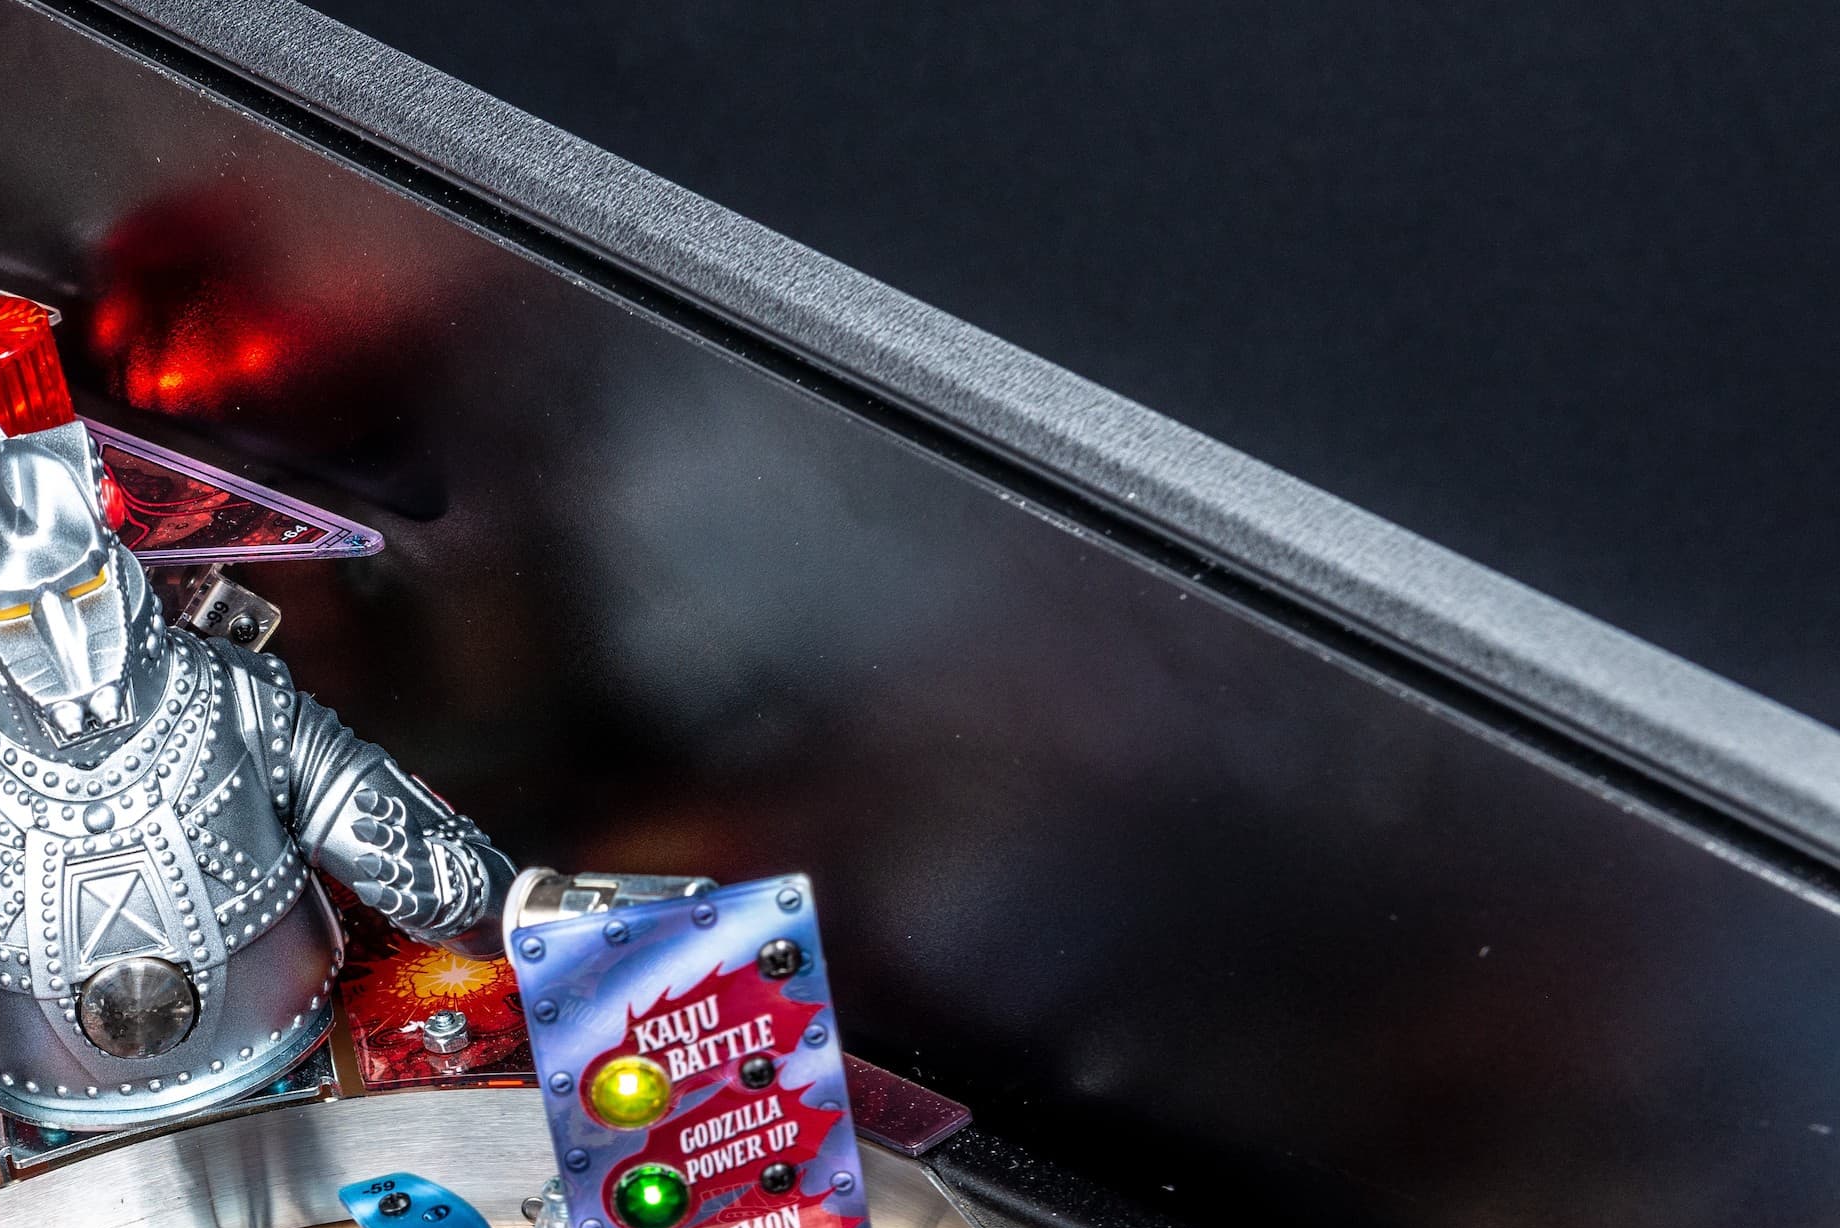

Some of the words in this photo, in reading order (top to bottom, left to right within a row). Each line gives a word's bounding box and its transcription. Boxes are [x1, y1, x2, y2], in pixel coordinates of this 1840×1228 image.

[633, 995, 720, 1055] KAIJU
[666, 1014, 775, 1083] BATTLE
[680, 1095, 784, 1154] GODZILLA
[686, 1136, 766, 1184] POWER
[767, 1120, 801, 1153] UP
[363, 1180, 396, 1195] -59
